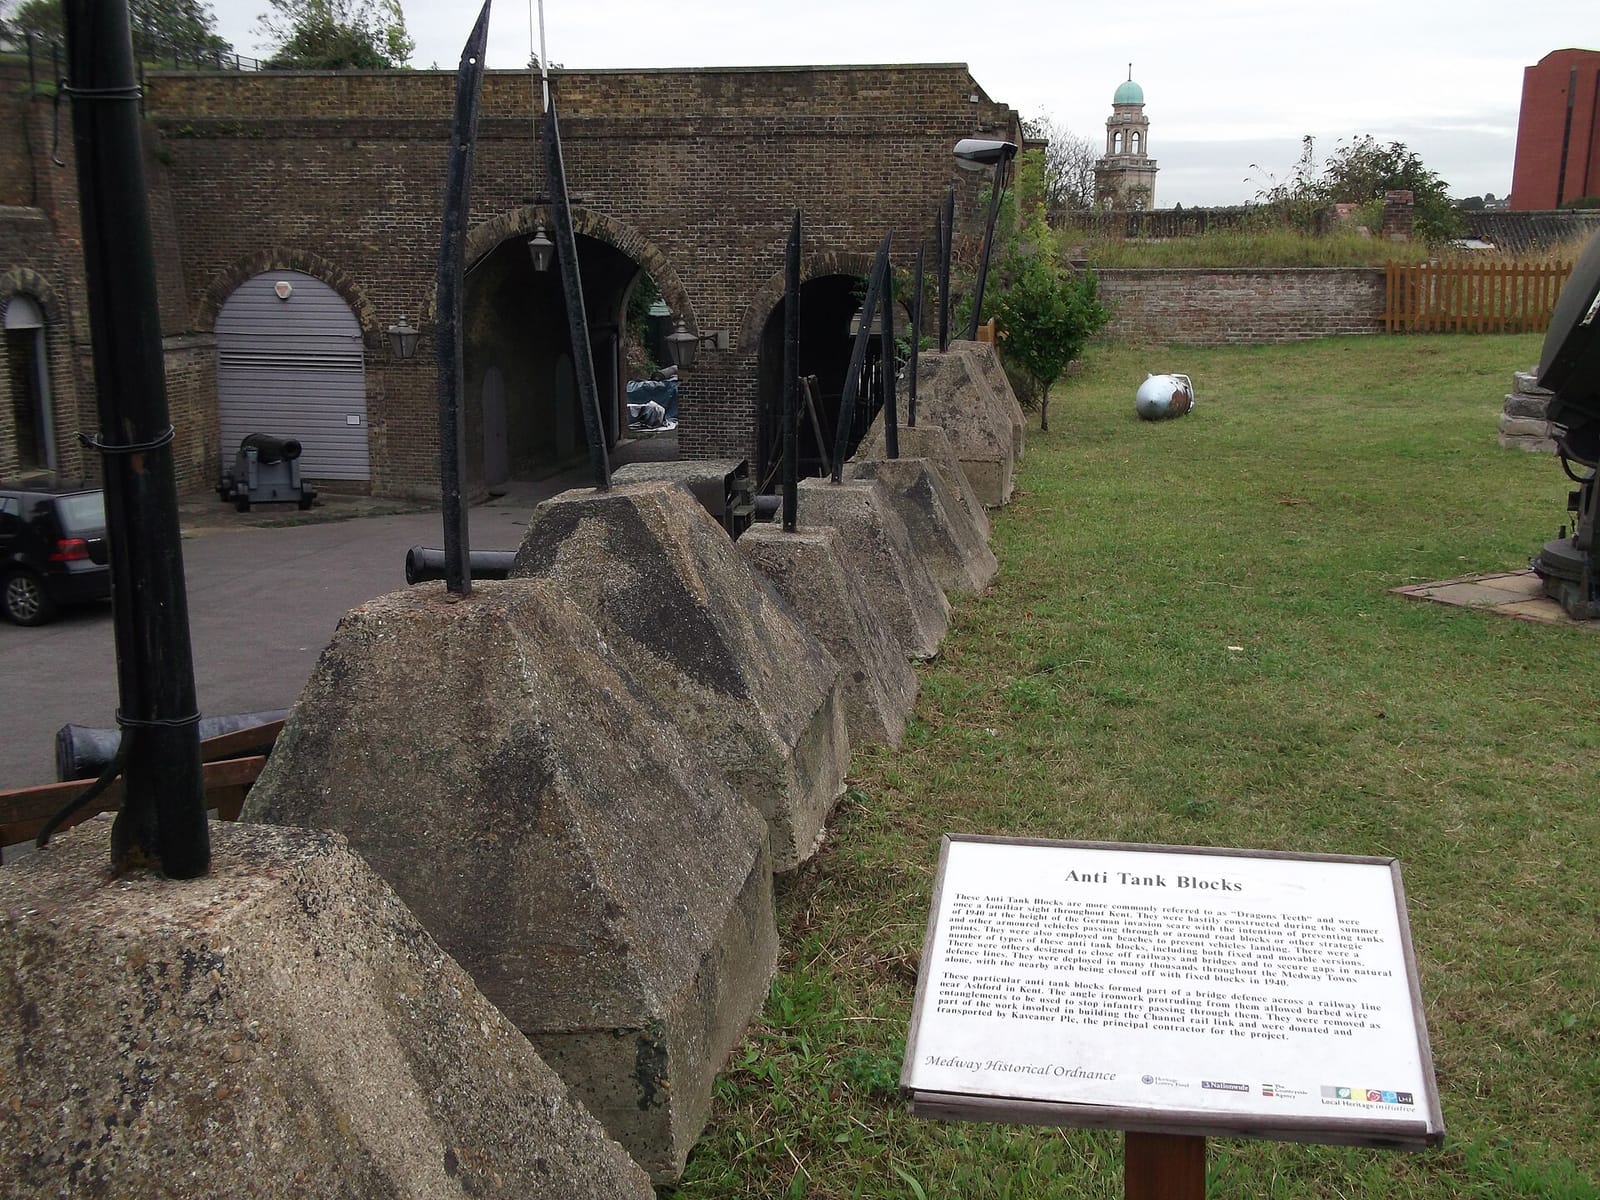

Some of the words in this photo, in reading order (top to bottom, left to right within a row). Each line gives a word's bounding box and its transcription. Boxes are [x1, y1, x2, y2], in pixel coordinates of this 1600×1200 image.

[1064, 869, 1107, 884] Anti
[1116, 872, 1167, 887] Tank
[1177, 875, 1243, 892] Blocks
[947, 939, 971, 948] There
[1001, 941, 1029, 950] others
[1033, 945, 1073, 954] designed
[1136, 953, 1175, 962] railways
[1202, 956, 1236, 966] bridges
[1312, 966, 1334, 974] gaps
[948, 929, 980, 940] number
[999, 935, 1022, 944] types
[1040, 937, 1063, 946] these
[1067, 937, 1085, 946] anti
[1116, 942, 1148, 952] blocks,
[1152, 944, 1197, 956] including
[1202, 948, 1223, 956] both
[1227, 950, 1251, 958] fixed
[1321, 958, 1365, 966] versions.
[983, 925, 1003, 934] They
[1056, 930, 1097, 940] employed
[1117, 934, 1152, 944] beaches
[1208, 941, 1245, 950] vehicles
[1250, 943, 1290, 954] landing.
[1294, 946, 1322, 954] There
[944, 955, 972, 964] alone,
[976, 958, 995, 966] with
[1018, 959, 1048, 970] nearby
[1078, 963, 1104, 974] being
[1108, 967, 1136, 976] closed
[1185, 972, 1209, 980] fixed
[1214, 974, 1244, 982] blocks
[1264, 978, 1289, 986] 1940.
[945, 947, 978, 956] defence
[983, 949, 1008, 958] lines.
[1011, 951, 1032, 960] They
[1062, 955, 1101, 964] deployed
[1106, 958, 1115, 966] in
[1150, 961, 1197, 970] thousands
[1202, 965, 1256, 976] throughout
[1282, 970, 1320, 982] Medway
[1326, 972, 1356, 982] Towns
[942, 971, 968, 980] These
[972, 975, 1019, 984] particular
[1025, 978, 1043, 986] anti
[1048, 980, 1069, 988] tank
[1074, 981, 1103, 990] blocks
[1108, 983, 1141, 992] formed
[1171, 988, 1180, 996] of
[1196, 990, 1224, 1000] bridge
[1230, 993, 1265, 1002] defence
[1318, 1000, 1355, 1010] railway
[1361, 1002, 1380, 1010] line
[965, 980, 1001, 990] Ashford
[1006, 984, 1014, 992] in
[1020, 985, 1044, 994] Kent.
[1048, 987, 1065, 996] The
[1070, 990, 1096, 998] angle
[1101, 991, 1143, 1002] ironwork
[1148, 997, 1201, 1006] protruding
[1206, 999, 1229, 1008] from
[1235, 1002, 1259, 1010] them
[1264, 1004, 1301, 1014] allowed
[1306, 1007, 1340, 1016] barbed
[1345, 1009, 1367, 1018] wire
[937, 1006, 992, 1016] transported
[996, 1009, 1005, 1018] by
[1060, 1015, 1079, 1024] Plc,
[1083, 1016, 1098, 1024] the
[1103, 1019, 1147, 1030] principal
[1152, 1024, 1204, 1032] contractor
[1230, 1028, 1245, 1036] the
[1250, 1031, 1289, 1040] project.
[938, 998, 957, 1006] part
[976, 1000, 990, 1008] the
[995, 1002, 1017, 1010] work
[1022, 1003, 1059, 1012] involved
[1064, 1006, 1073, 1014] in
[1078, 1007, 1119, 1018] building
[1124, 1011, 1138, 1020] the
[1143, 1012, 1184, 1022] Channel
[1214, 1018, 1234, 1026] link
[1288, 1024, 1328, 1034] donated
[939, 990, 1007, 1000] entanglements
[1025, 994, 1035, 1002] be
[1078, 1000, 1098, 1008] stop
[1103, 1000, 1142, 1012] infantry
[1148, 1002, 1184, 1014] passing
[1190, 1007, 1229, 1018] through
[1234, 1011, 1262, 1020] them.
[1266, 1013, 1289, 1024] They
[1323, 1019, 1364, 1028] removed
[925, 1055, 982, 1073] Medway
[984, 1060, 1052, 1076] Historical
[1053, 1066, 1117, 1081] Ordnance
[1343, 1100, 1374, 1110] Heritage
